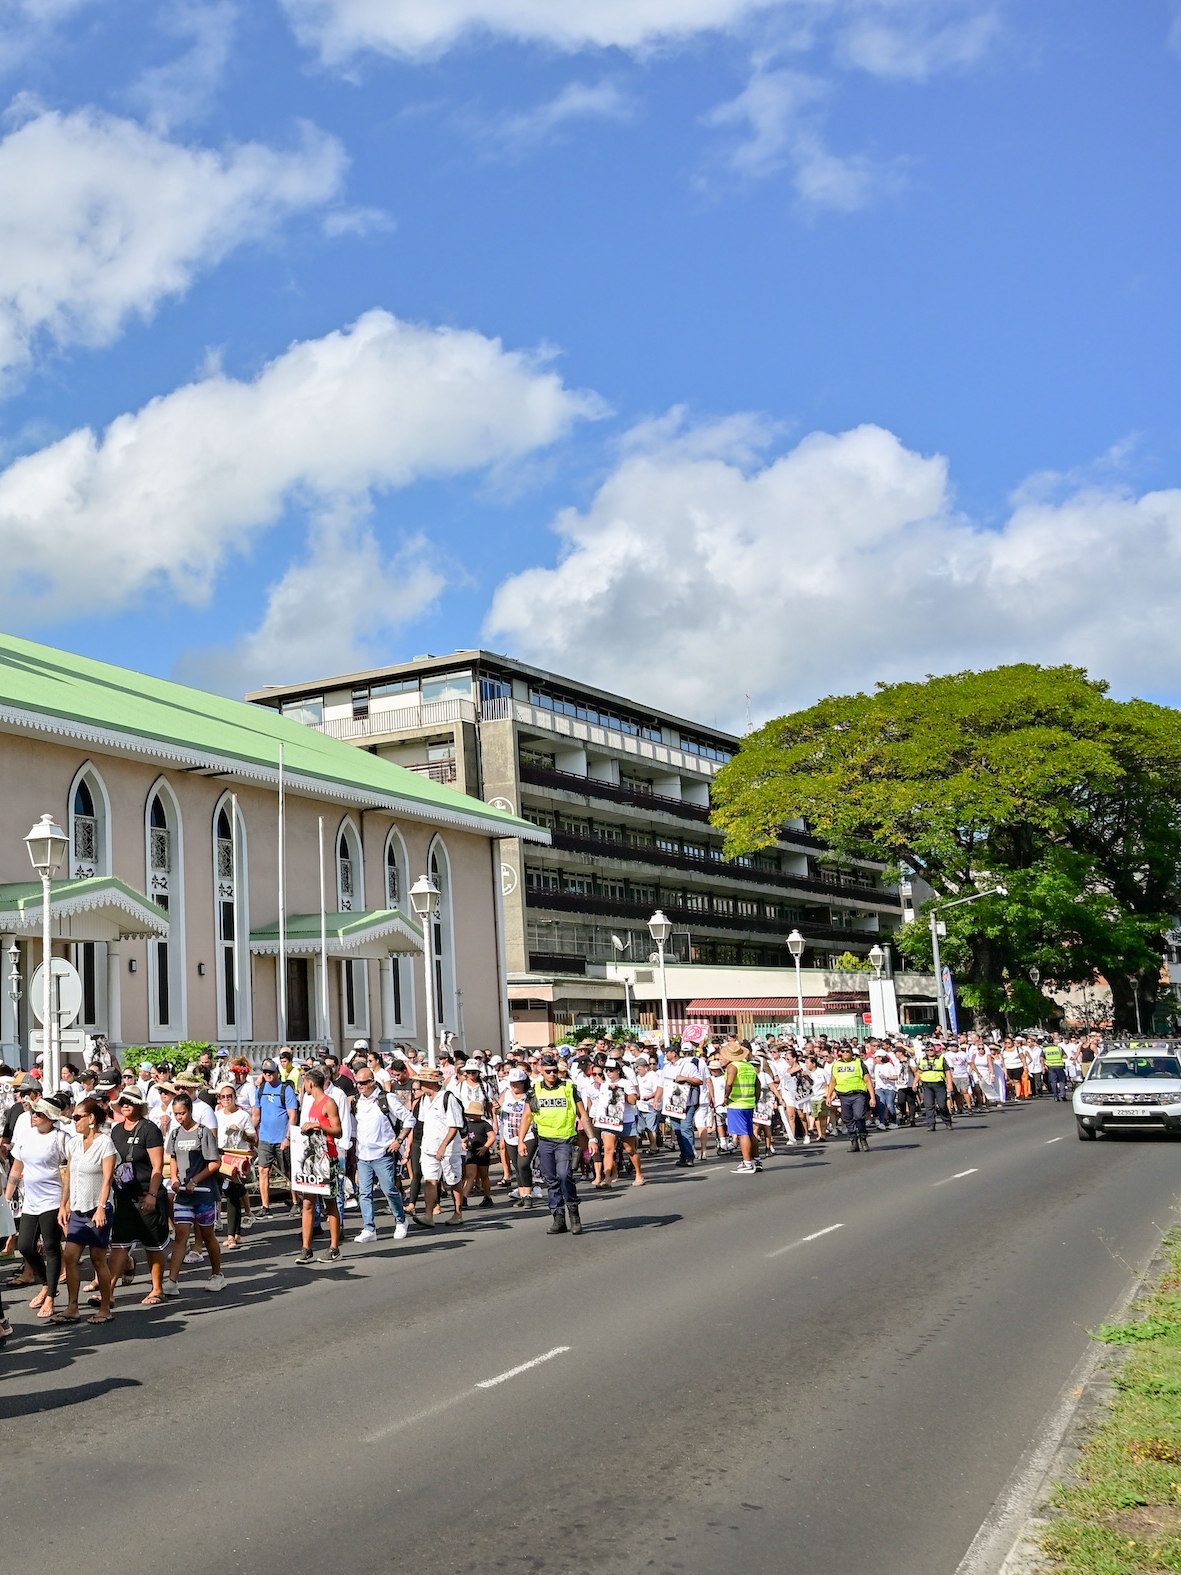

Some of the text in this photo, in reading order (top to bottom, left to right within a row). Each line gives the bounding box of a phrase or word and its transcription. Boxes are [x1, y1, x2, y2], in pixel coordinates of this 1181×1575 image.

[539, 1098, 567, 1107] POLICE
[665, 1104, 684, 1113] STOP
[600, 1115, 620, 1125] STOP
[753, 1111, 768, 1120] TOP
[296, 1173, 324, 1185] STOP
